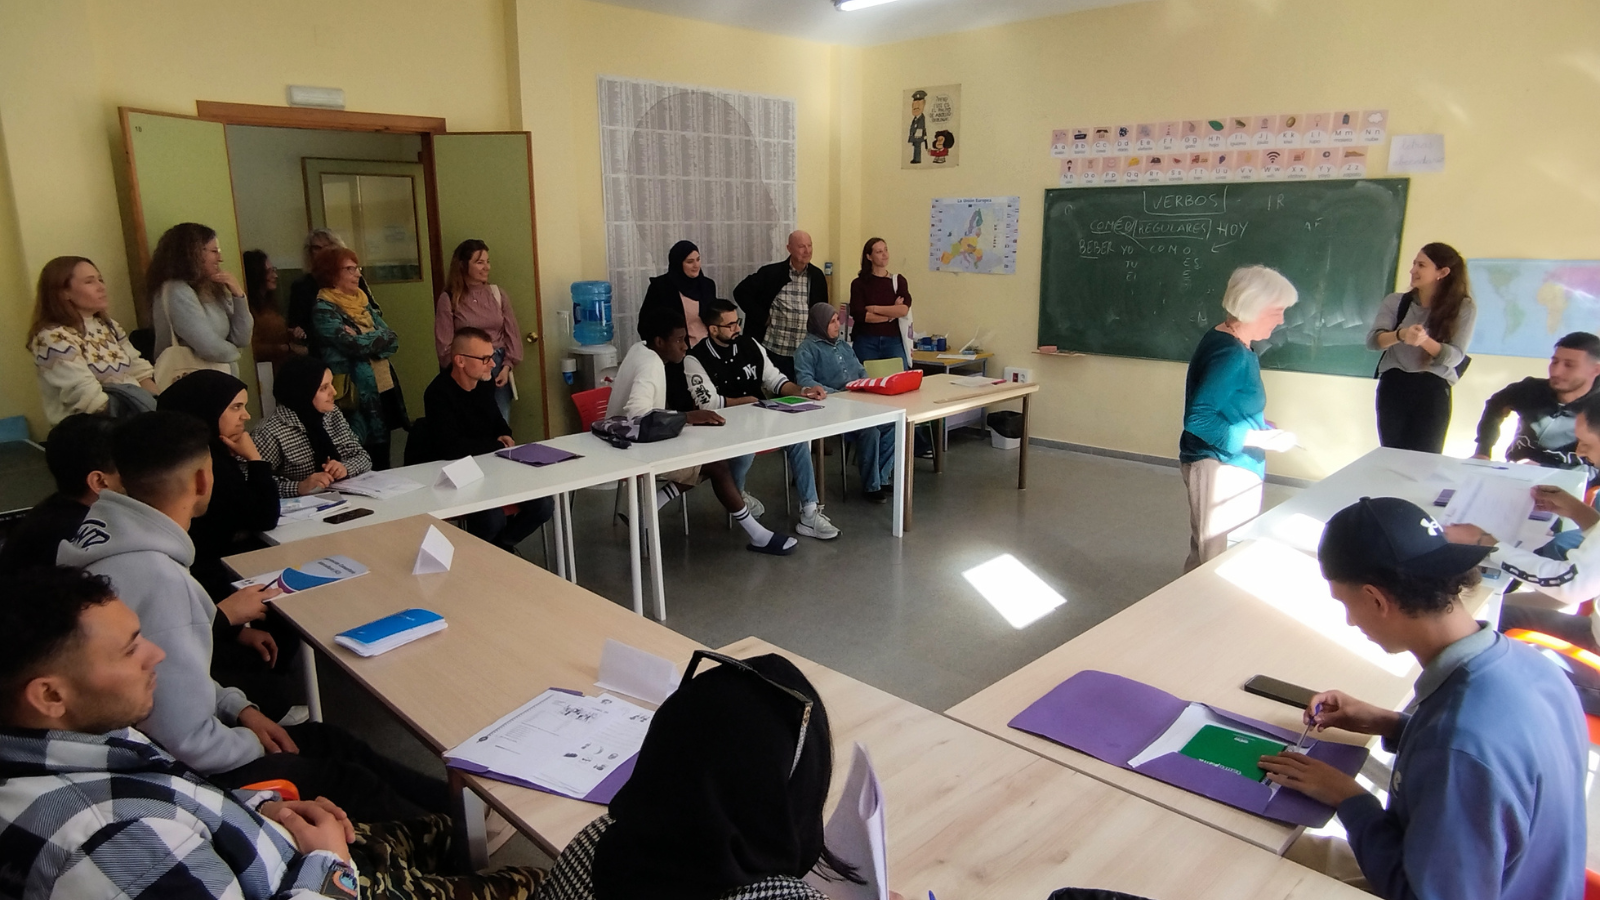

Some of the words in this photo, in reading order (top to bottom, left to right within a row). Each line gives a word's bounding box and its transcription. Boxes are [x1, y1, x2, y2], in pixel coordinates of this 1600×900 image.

[1152, 194, 1218, 210] VERBOS
[1267, 193, 1285, 211] IR
[1137, 221, 1207, 234] REGULARES
[1216, 221, 1248, 238] HOY
[1078, 239, 1115, 255] BEBER
[1121, 245, 1134, 255] YO
[742, 363, 758, 380] NY
